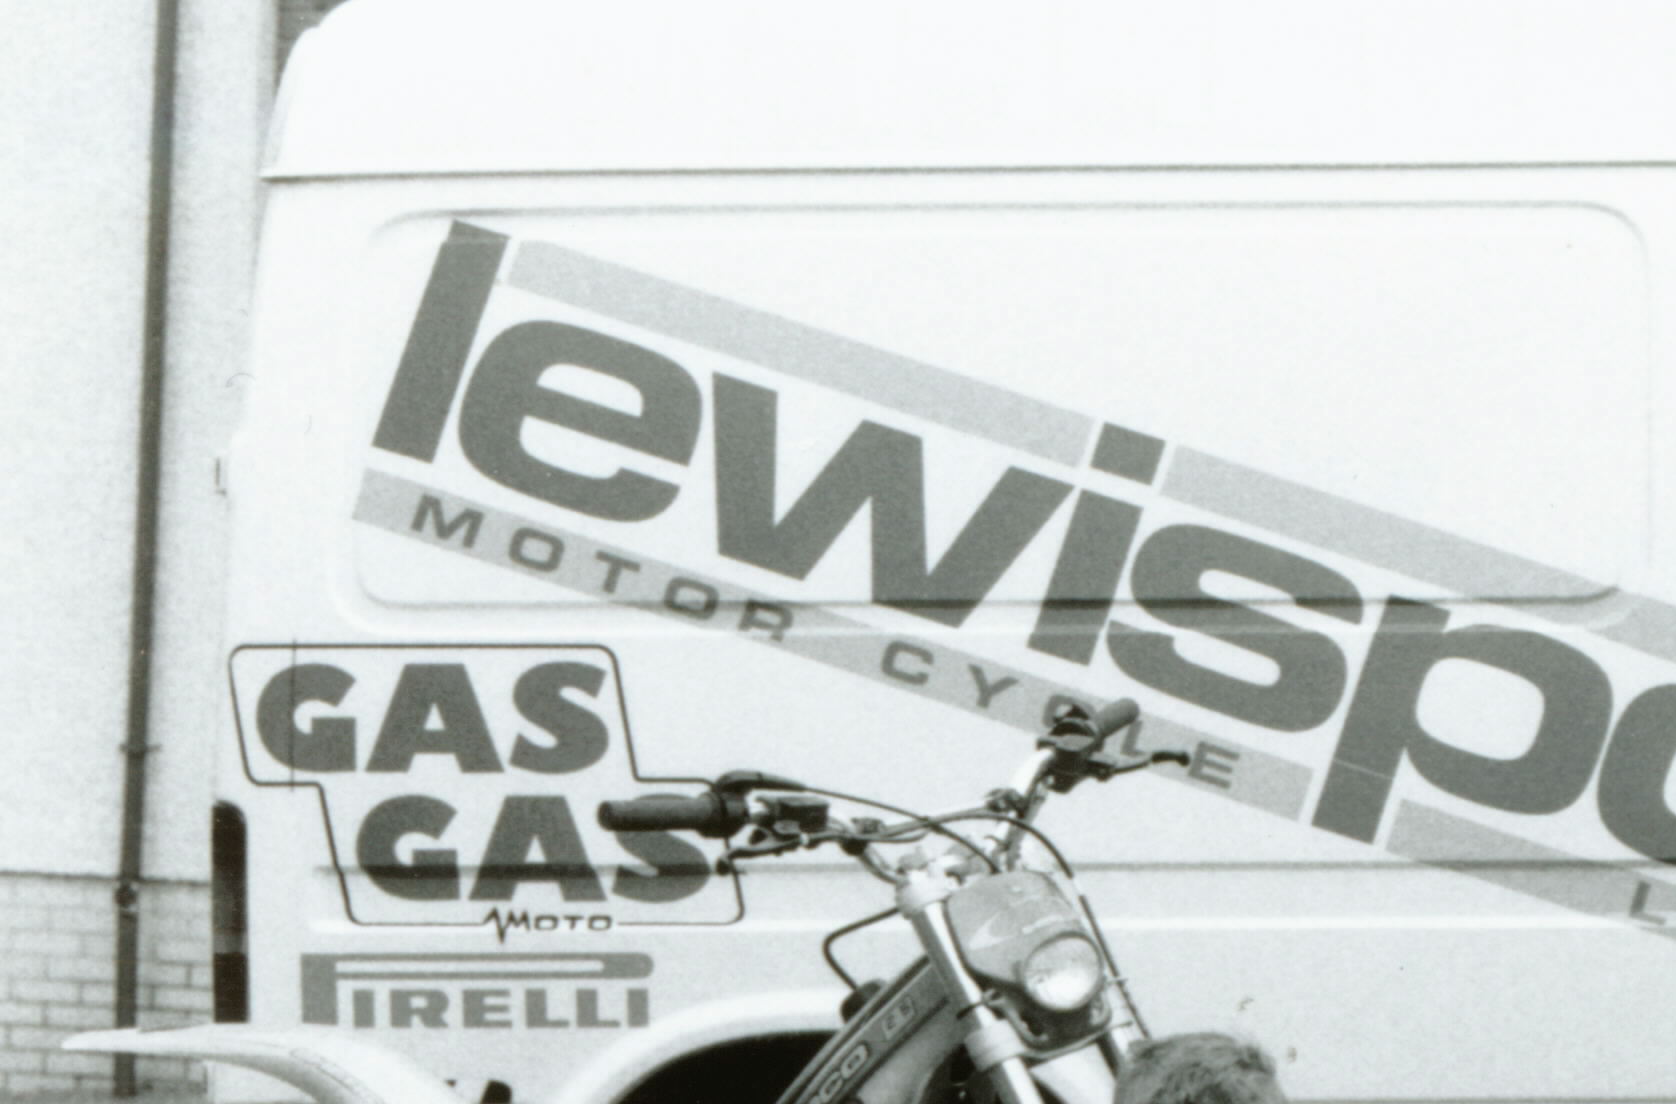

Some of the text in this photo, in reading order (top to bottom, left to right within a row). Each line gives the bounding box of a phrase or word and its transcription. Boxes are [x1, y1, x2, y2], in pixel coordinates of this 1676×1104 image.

[410, 494, 794, 642] MOTOR
[256, 661, 609, 774] GAS
[356, 795, 712, 902] GAS
[300, 953, 654, 1028] PIRELLI
